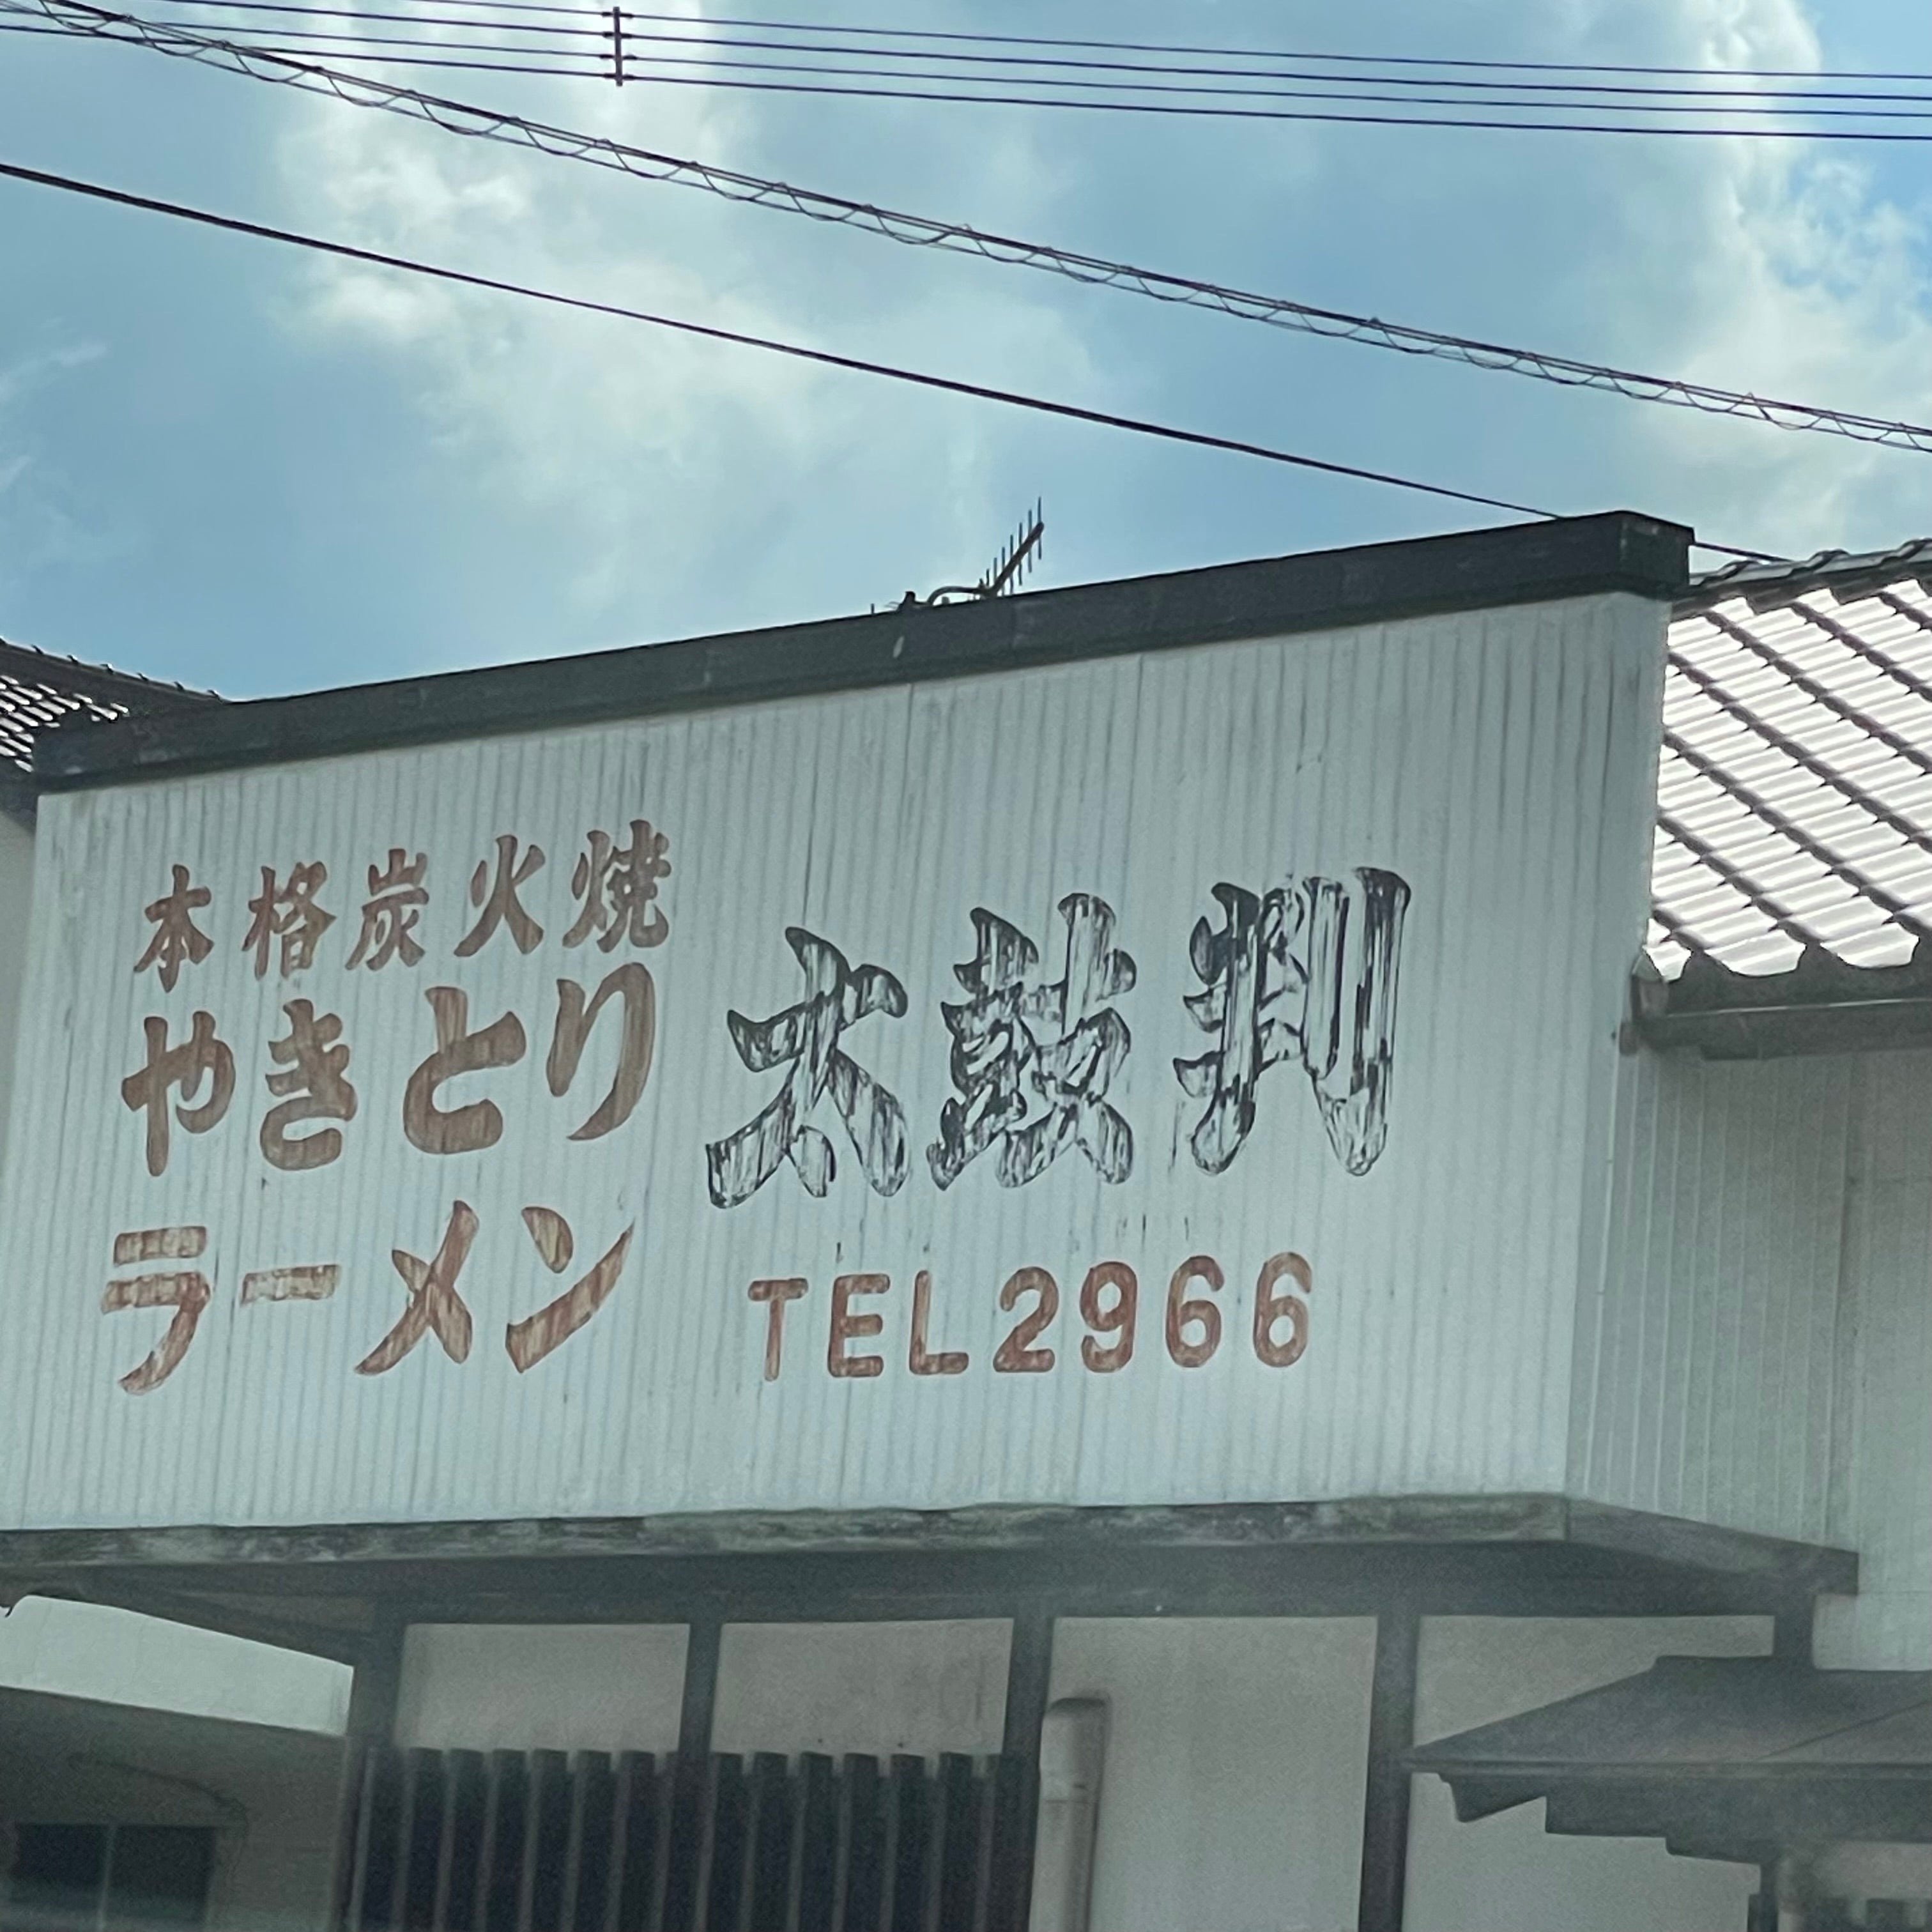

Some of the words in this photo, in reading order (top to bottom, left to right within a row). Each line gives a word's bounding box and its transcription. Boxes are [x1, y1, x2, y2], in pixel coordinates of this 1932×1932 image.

[133, 819, 672, 993] 本格炭火焼
[121, 962, 657, 1177] やきとり
[100, 1199, 636, 1395] ラーメン
